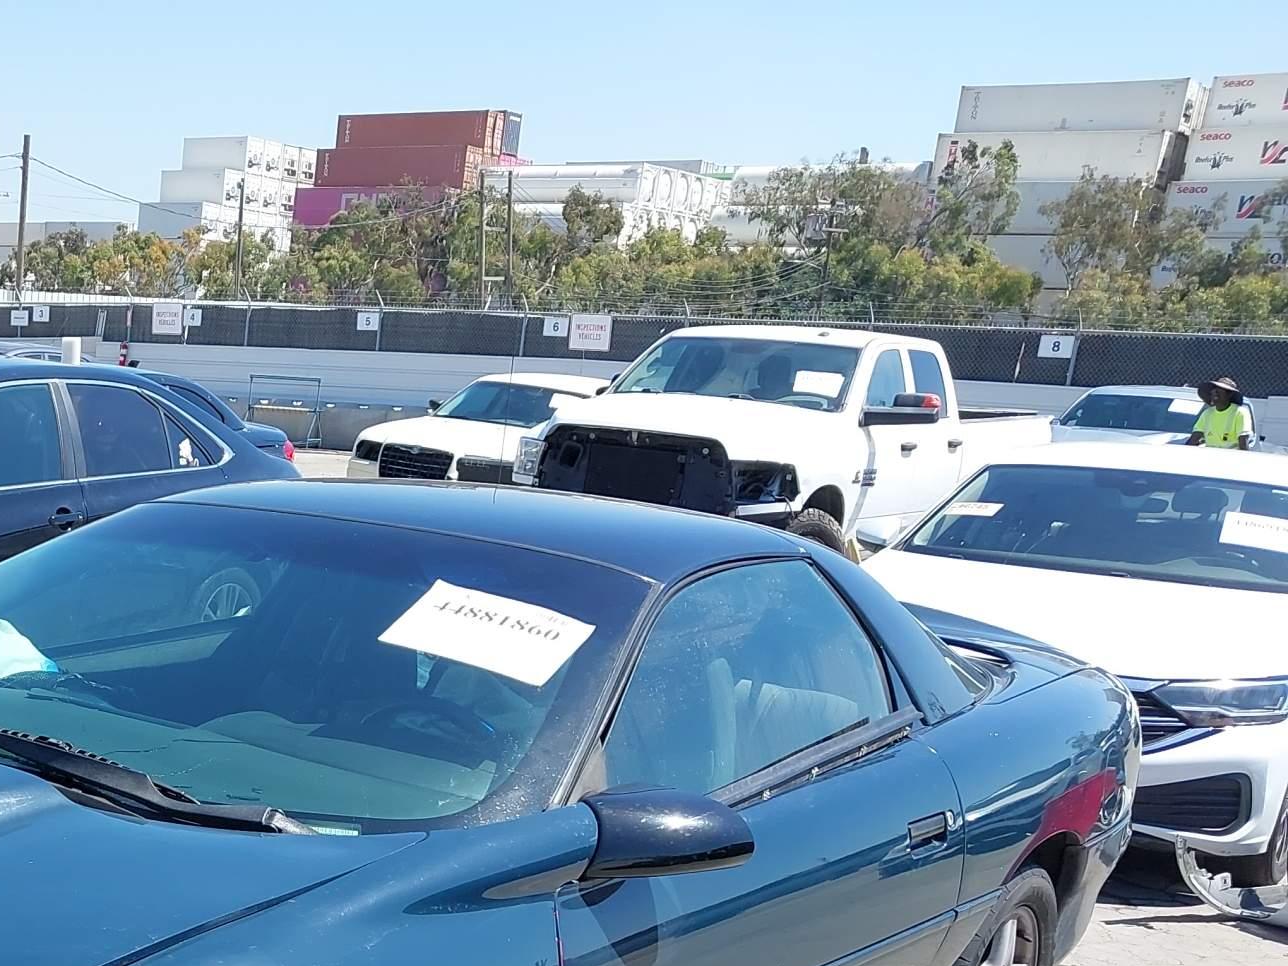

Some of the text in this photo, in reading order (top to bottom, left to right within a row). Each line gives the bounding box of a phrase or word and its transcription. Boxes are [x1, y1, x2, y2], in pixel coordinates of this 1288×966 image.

[1223, 80, 1255, 88] seaco
[1200, 133, 1232, 141] seaco
[1176, 185, 1208, 194] seaco
[365, 317, 371, 326] 5
[553, 322, 560, 332] 6
[576, 324, 606, 332] INSPECTIONS
[578, 333, 601, 341] VEHICLES
[1052, 341, 1060, 352] 8
[433, 601, 560, 641] 44881860
